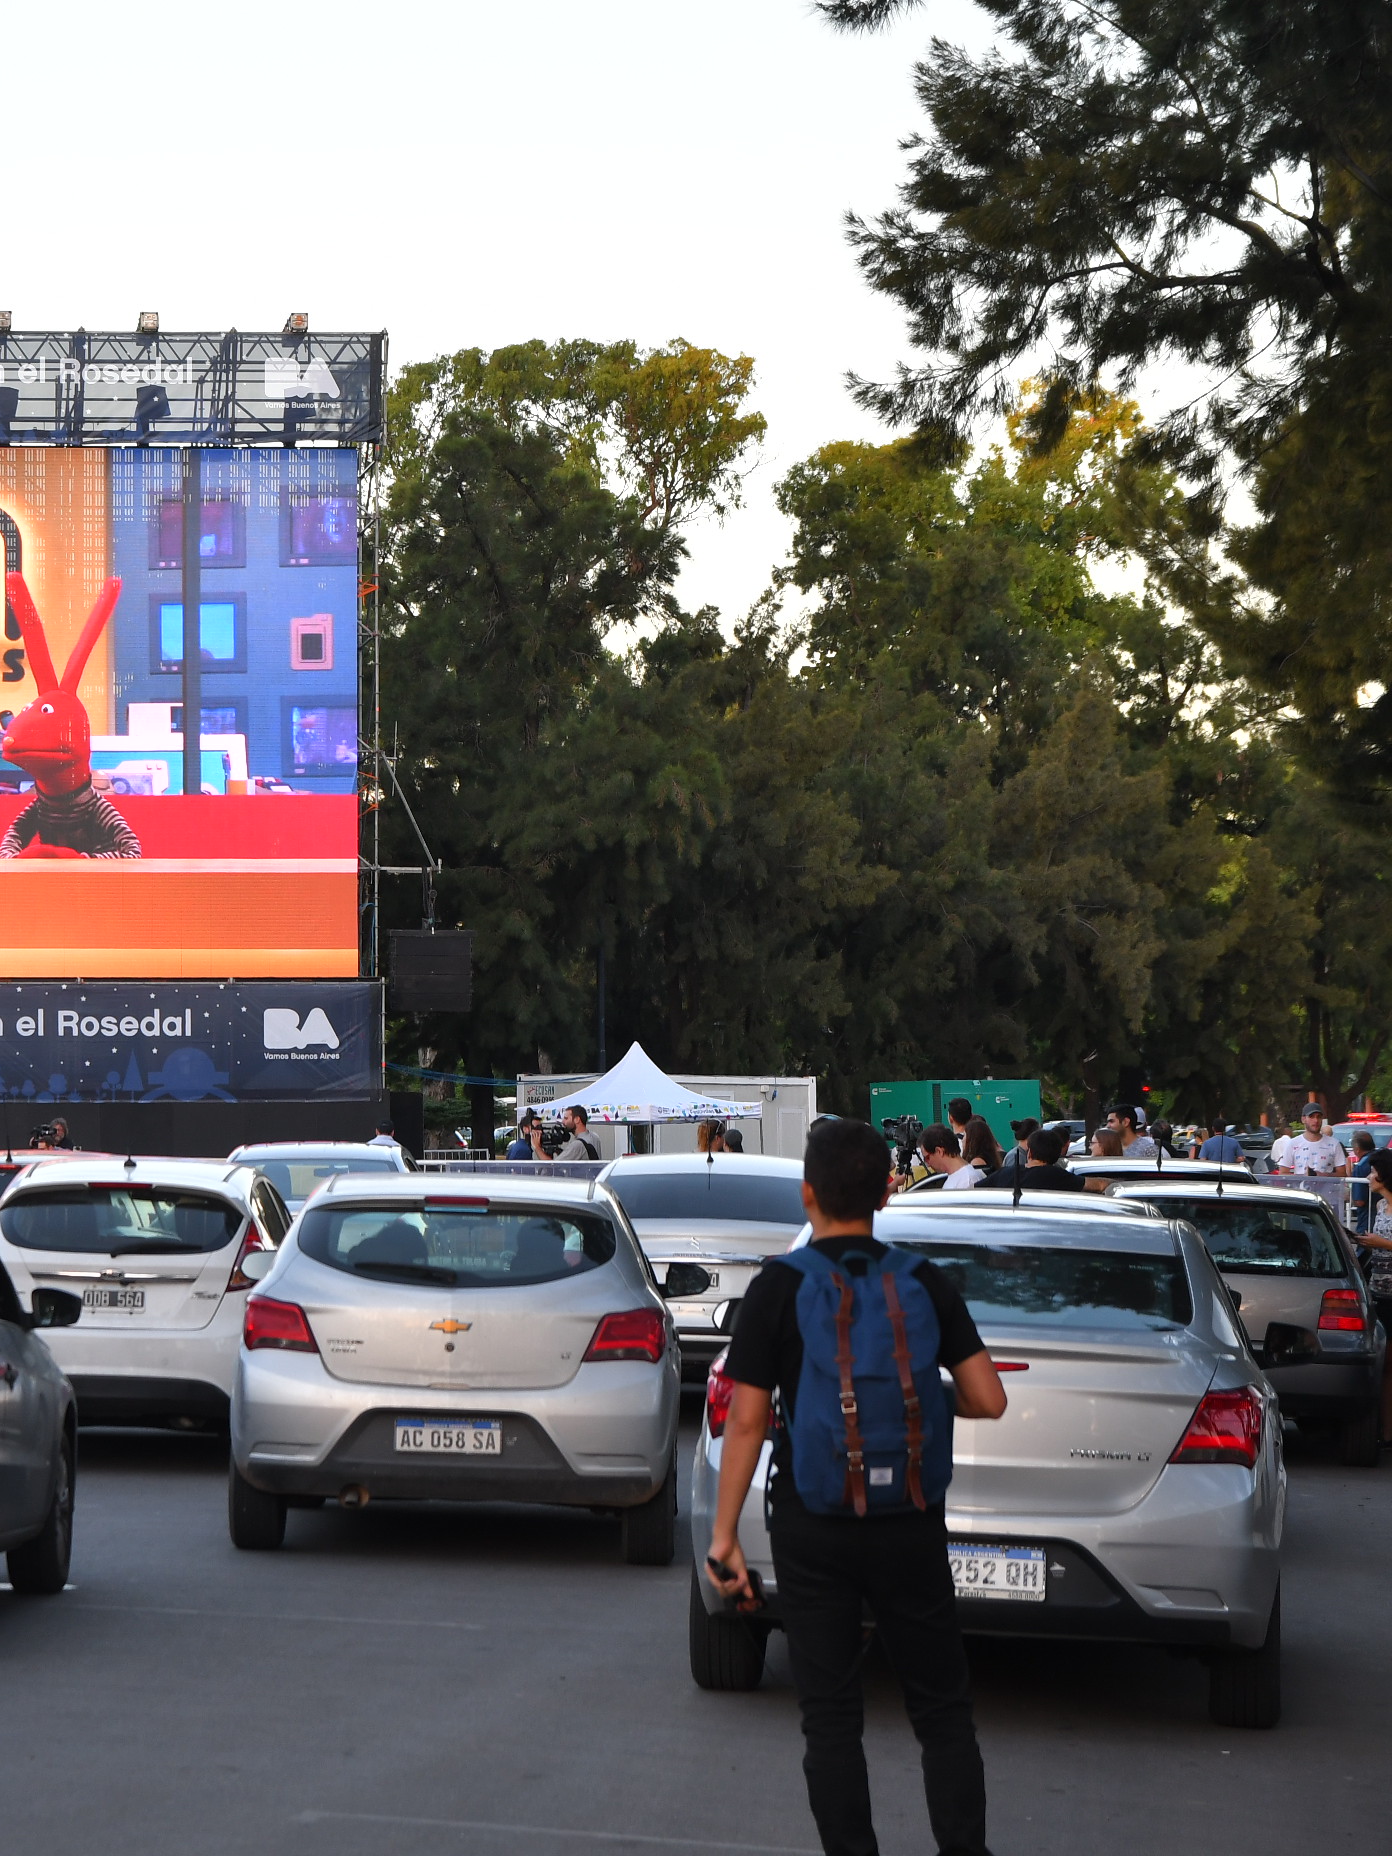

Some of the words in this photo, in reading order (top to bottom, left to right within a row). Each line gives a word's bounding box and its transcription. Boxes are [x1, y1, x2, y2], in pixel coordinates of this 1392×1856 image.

[17, 356, 46, 384] el
[59, 356, 194, 385] Rosedal
[264, 356, 340, 398] BA
[16, 1008, 44, 1037] el
[58, 1009, 192, 1037] Rosedal
[263, 1007, 340, 1050] BA
[264, 1052, 289, 1060] Vamos
[290, 1052, 318, 1060] Buenos
[319, 1052, 340, 1060] Aires
[117, 1291, 144, 1308] 564
[400, 1429, 424, 1449] AC
[430, 1430, 466, 1450] 058
[472, 1431, 496, 1451] SA
[949, 1558, 997, 1585] 252
[1005, 1561, 1039, 1588] QH
